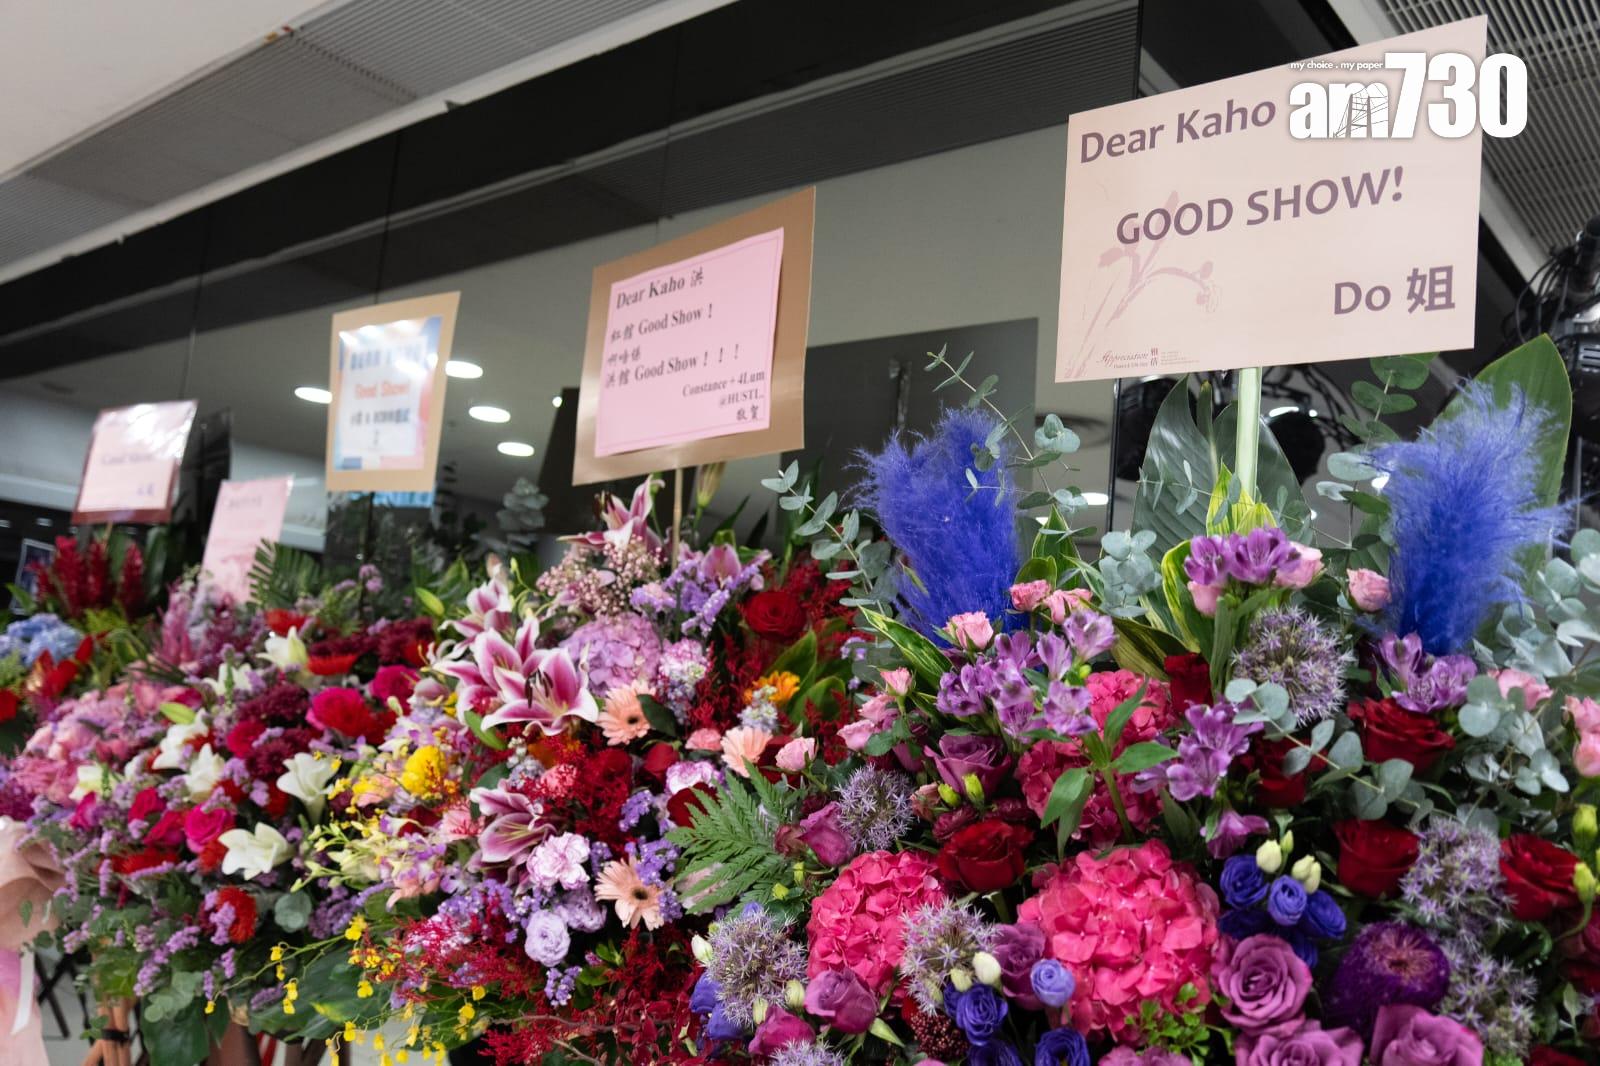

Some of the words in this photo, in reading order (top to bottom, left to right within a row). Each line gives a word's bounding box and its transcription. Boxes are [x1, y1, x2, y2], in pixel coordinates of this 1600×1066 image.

[1081, 124, 1164, 163] Dear
[1176, 99, 1276, 144] Kaho
[1116, 198, 1234, 245] GOOD
[1246, 166, 1404, 226] SHOW!
[616, 290, 645, 310] Dear
[649, 276, 686, 299] Kaho
[1334, 282, 1391, 315] Do
[1406, 265, 1455, 314] 姐
[638, 314, 668, 335] Good
[634, 360, 664, 381] Good
